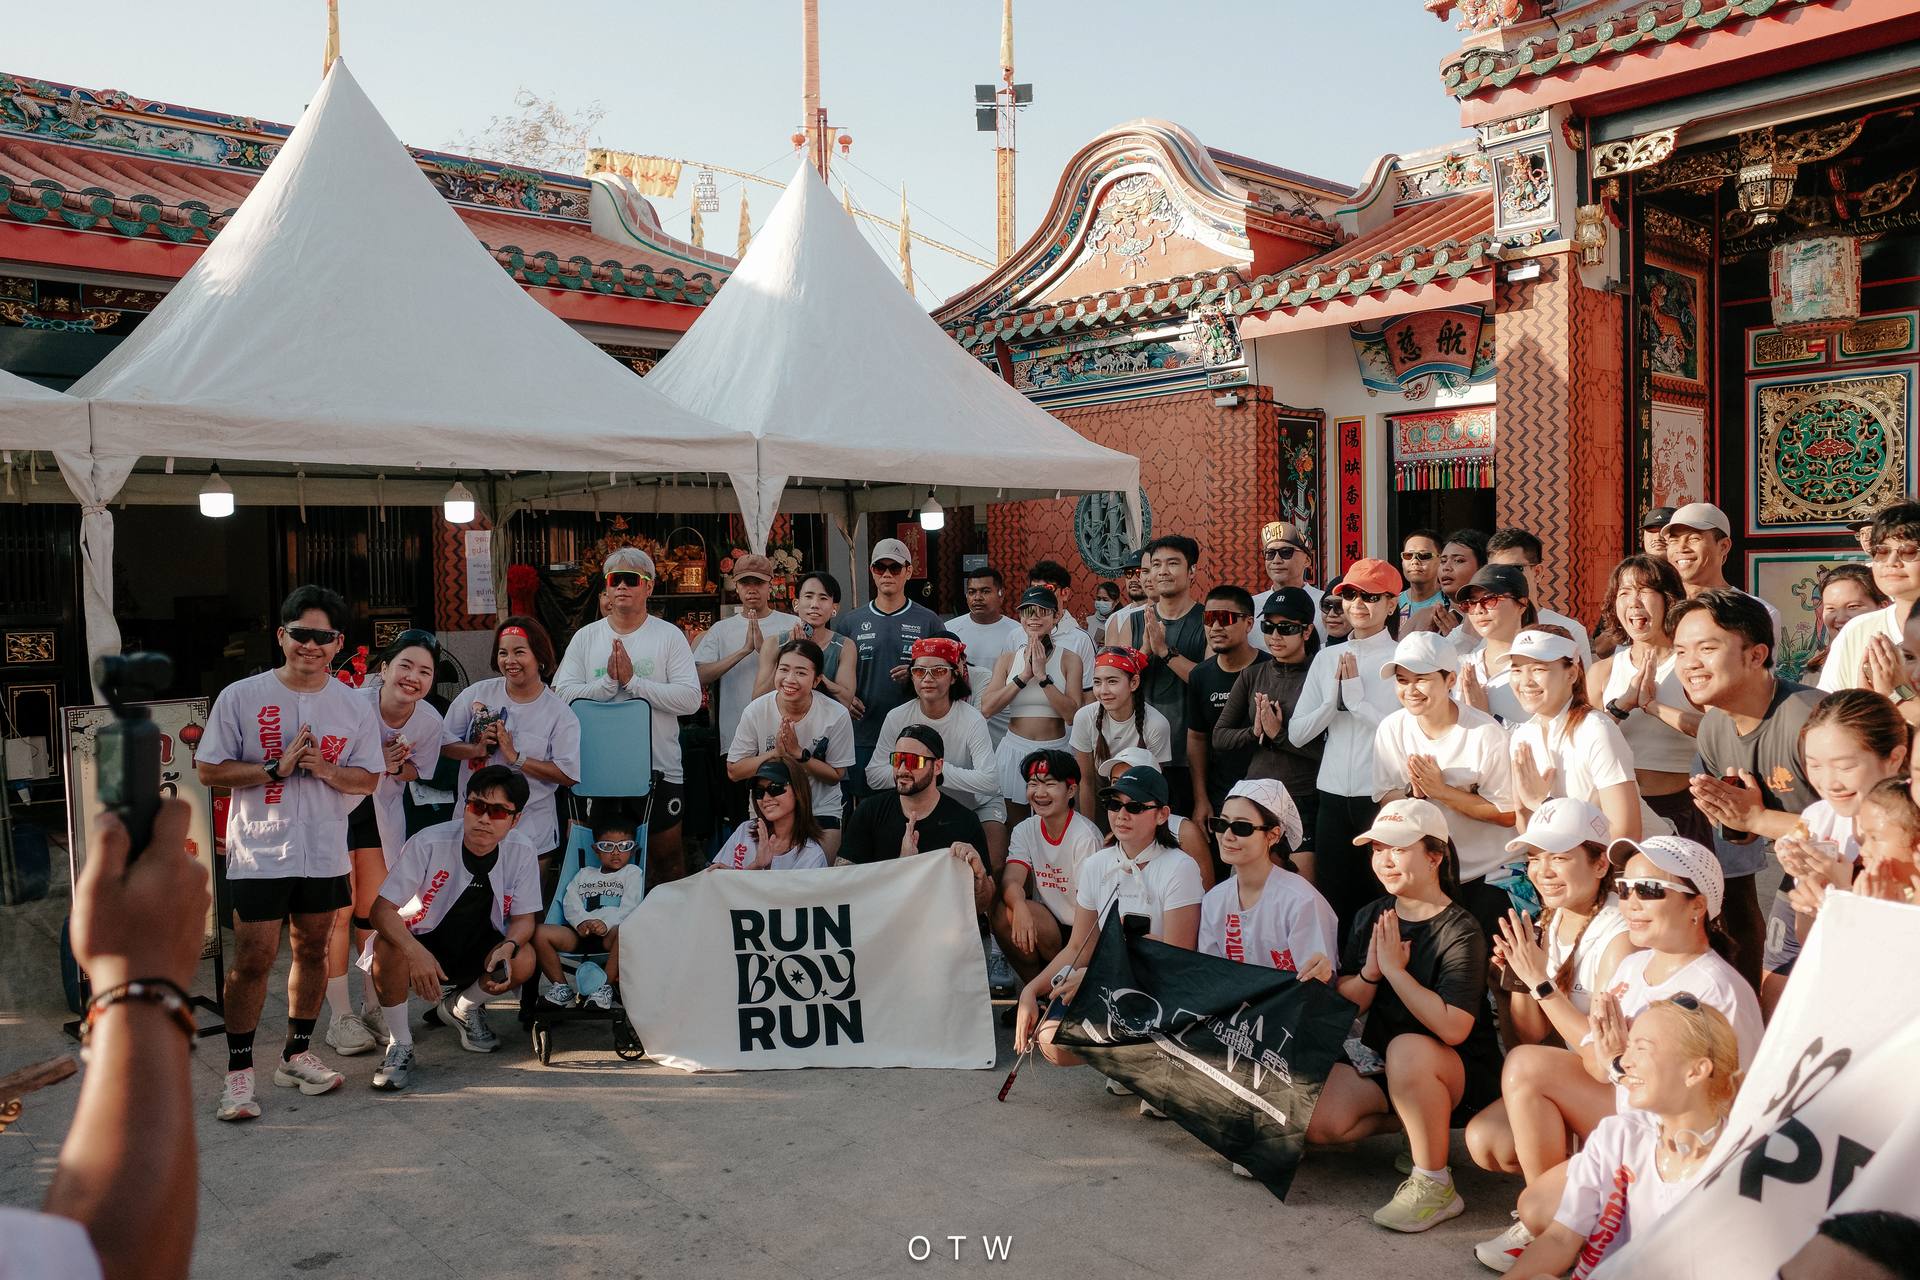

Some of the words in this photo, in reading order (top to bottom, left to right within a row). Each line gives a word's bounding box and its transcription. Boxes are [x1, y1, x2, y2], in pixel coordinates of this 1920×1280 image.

[730, 904, 853, 952] RUN
[735, 948, 857, 1005] BOY
[738, 1000, 865, 1052] RUN
[1191, 1057, 1240, 1093] COMMUNITY
